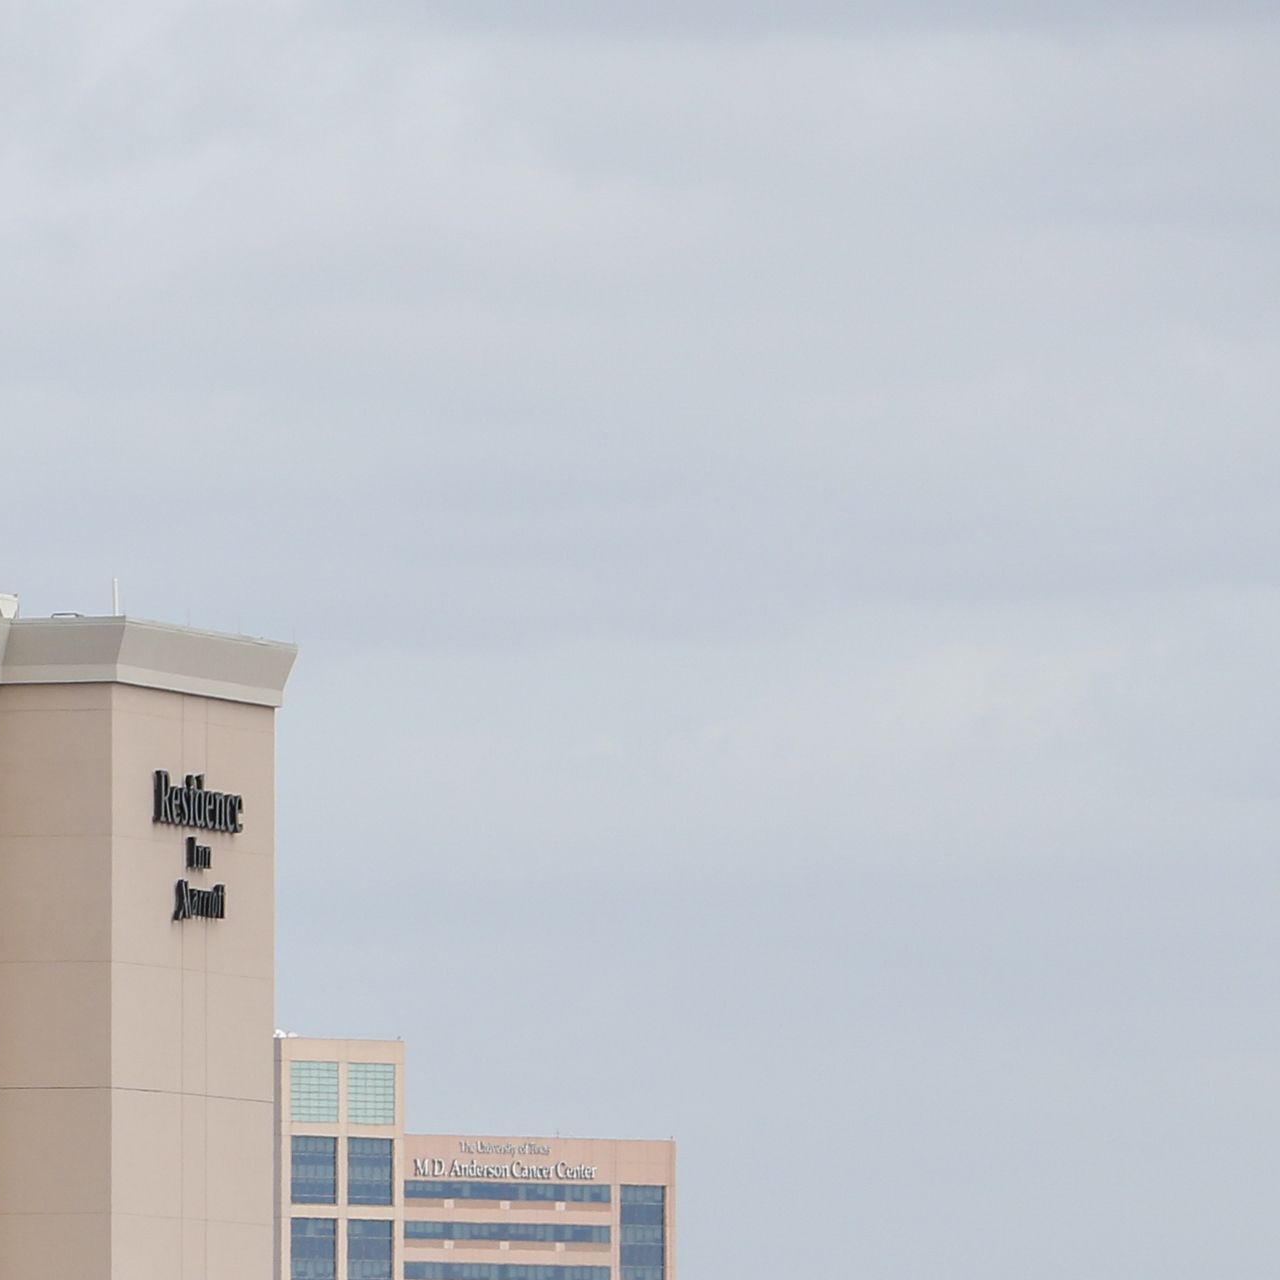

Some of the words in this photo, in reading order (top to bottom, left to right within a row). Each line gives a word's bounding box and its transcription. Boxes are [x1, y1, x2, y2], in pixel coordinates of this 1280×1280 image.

[152, 770, 243, 834] Residence
[186, 837, 211, 869] Inn
[450, 1159, 510, 1178] Anderson
[511, 1159, 554, 1179] Cancer
[555, 1161, 598, 1180] Center
